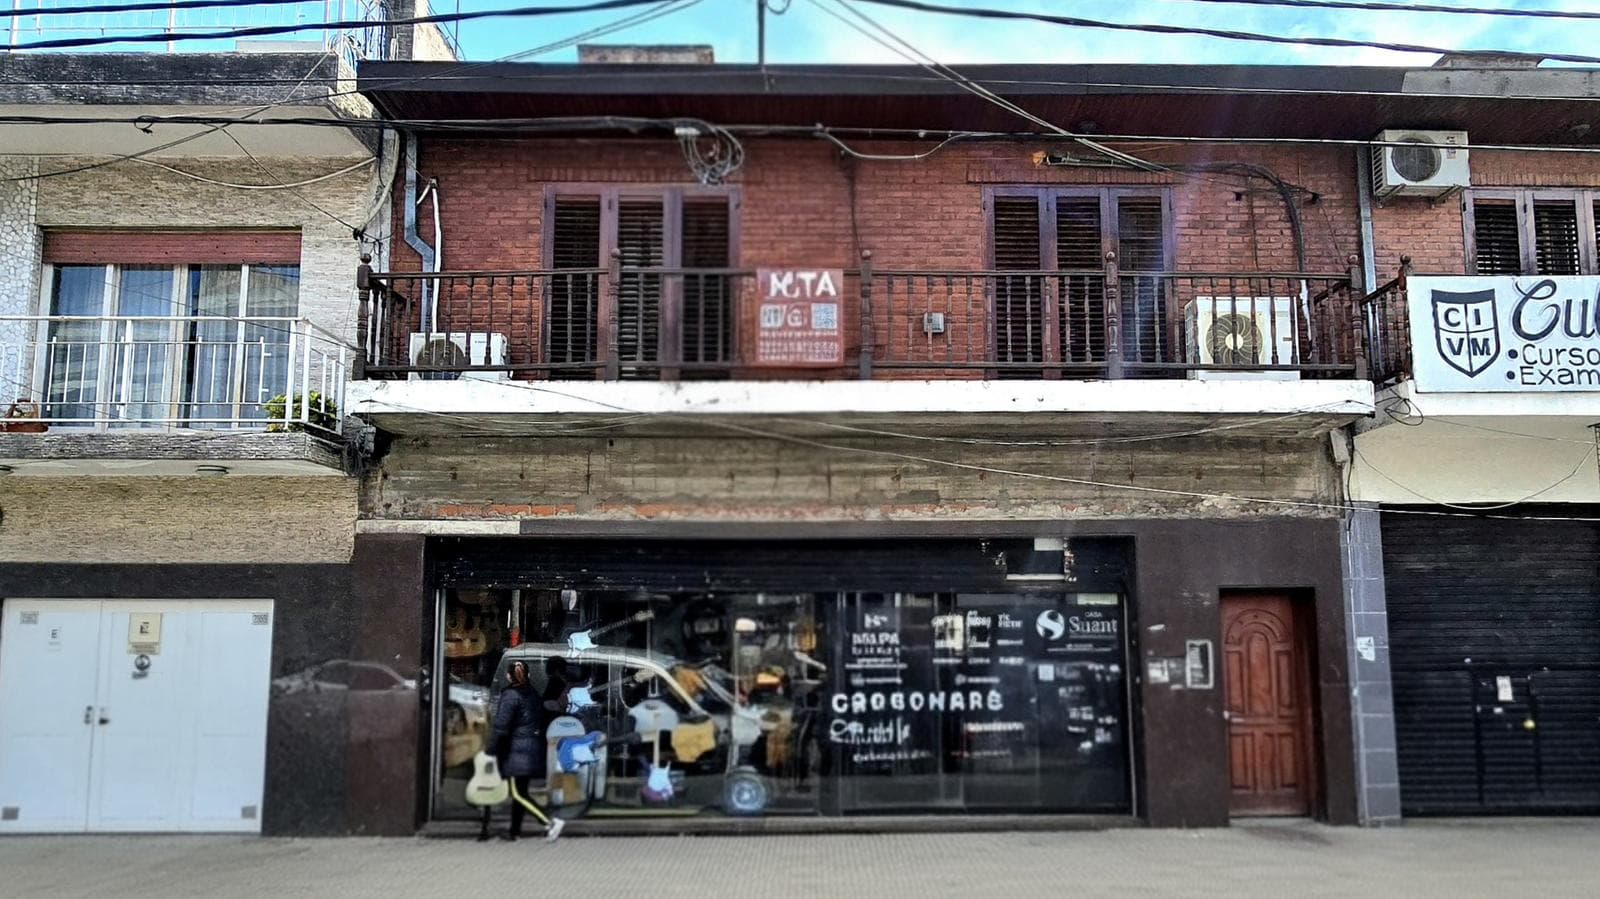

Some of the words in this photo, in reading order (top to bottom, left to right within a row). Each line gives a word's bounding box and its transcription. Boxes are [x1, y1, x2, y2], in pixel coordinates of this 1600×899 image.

[1512, 279, 1600, 341] Cu
[1522, 343, 1600, 366] Curso
[1520, 366, 1600, 386] Exam
